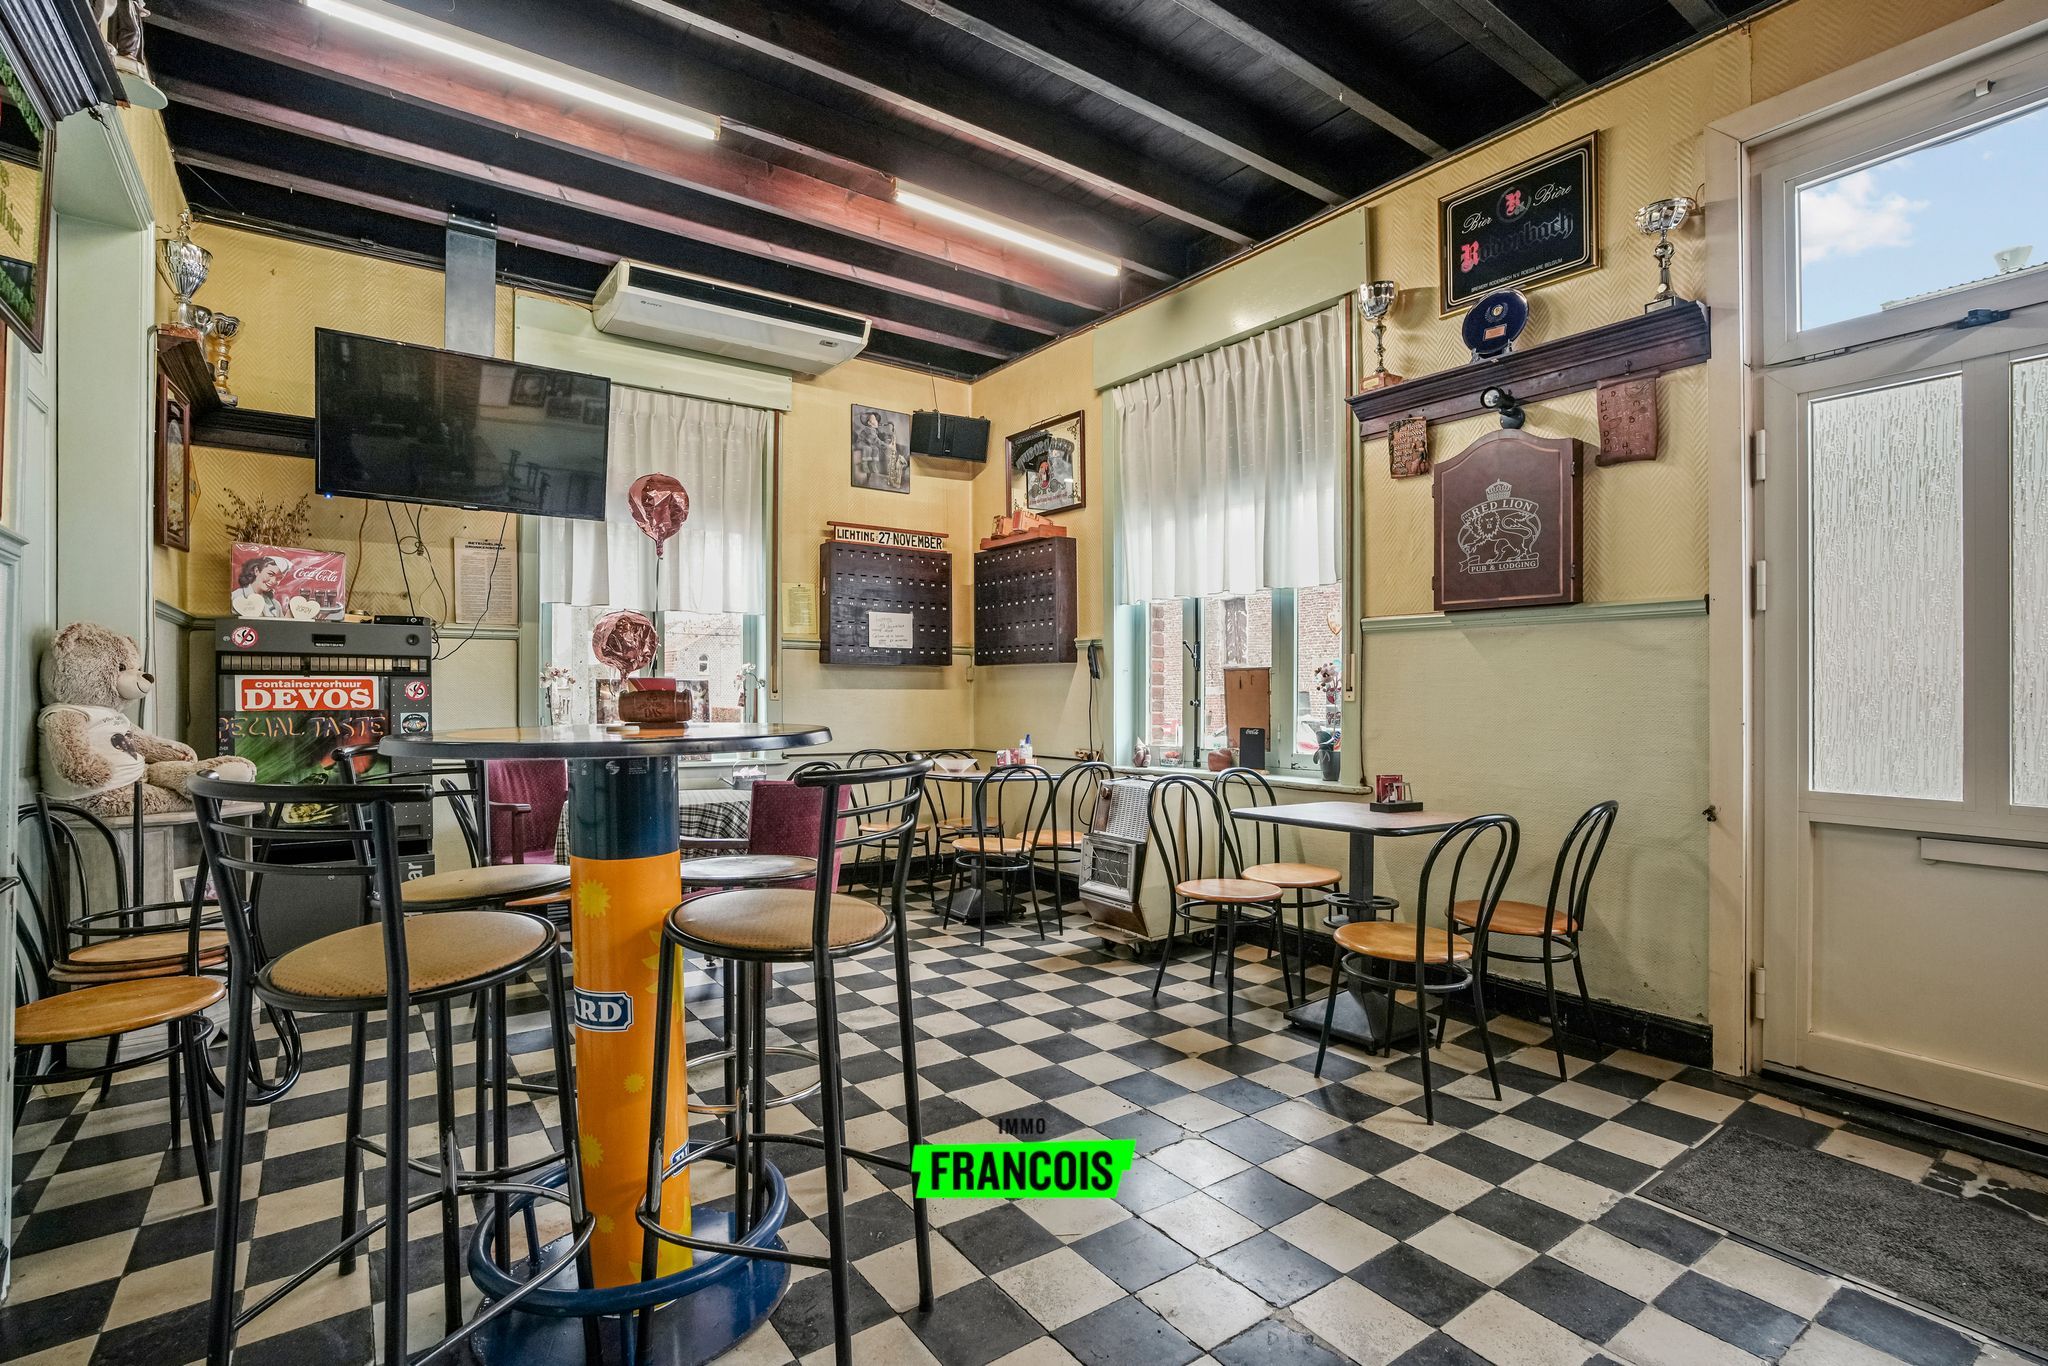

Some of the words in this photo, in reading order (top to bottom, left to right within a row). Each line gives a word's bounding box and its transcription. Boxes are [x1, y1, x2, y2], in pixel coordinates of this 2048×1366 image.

[1462, 211, 1493, 234] Bier
[1533, 183, 1572, 206] Bière
[1471, 283, 1488, 292] BREWERY
[1489, 275, 1512, 288] RODENBACH
[1521, 264, 1543, 276] ROESELARE
[1544, 257, 1563, 269] BELGIUM
[1472, 502, 1498, 518] RED
[1502, 500, 1533, 511] LION
[1499, 560, 1536, 570] LODGING
[255, 679, 362, 688] containerverhuur
[244, 688, 372, 709] DEVOS
[309, 716, 387, 737] TASTE
